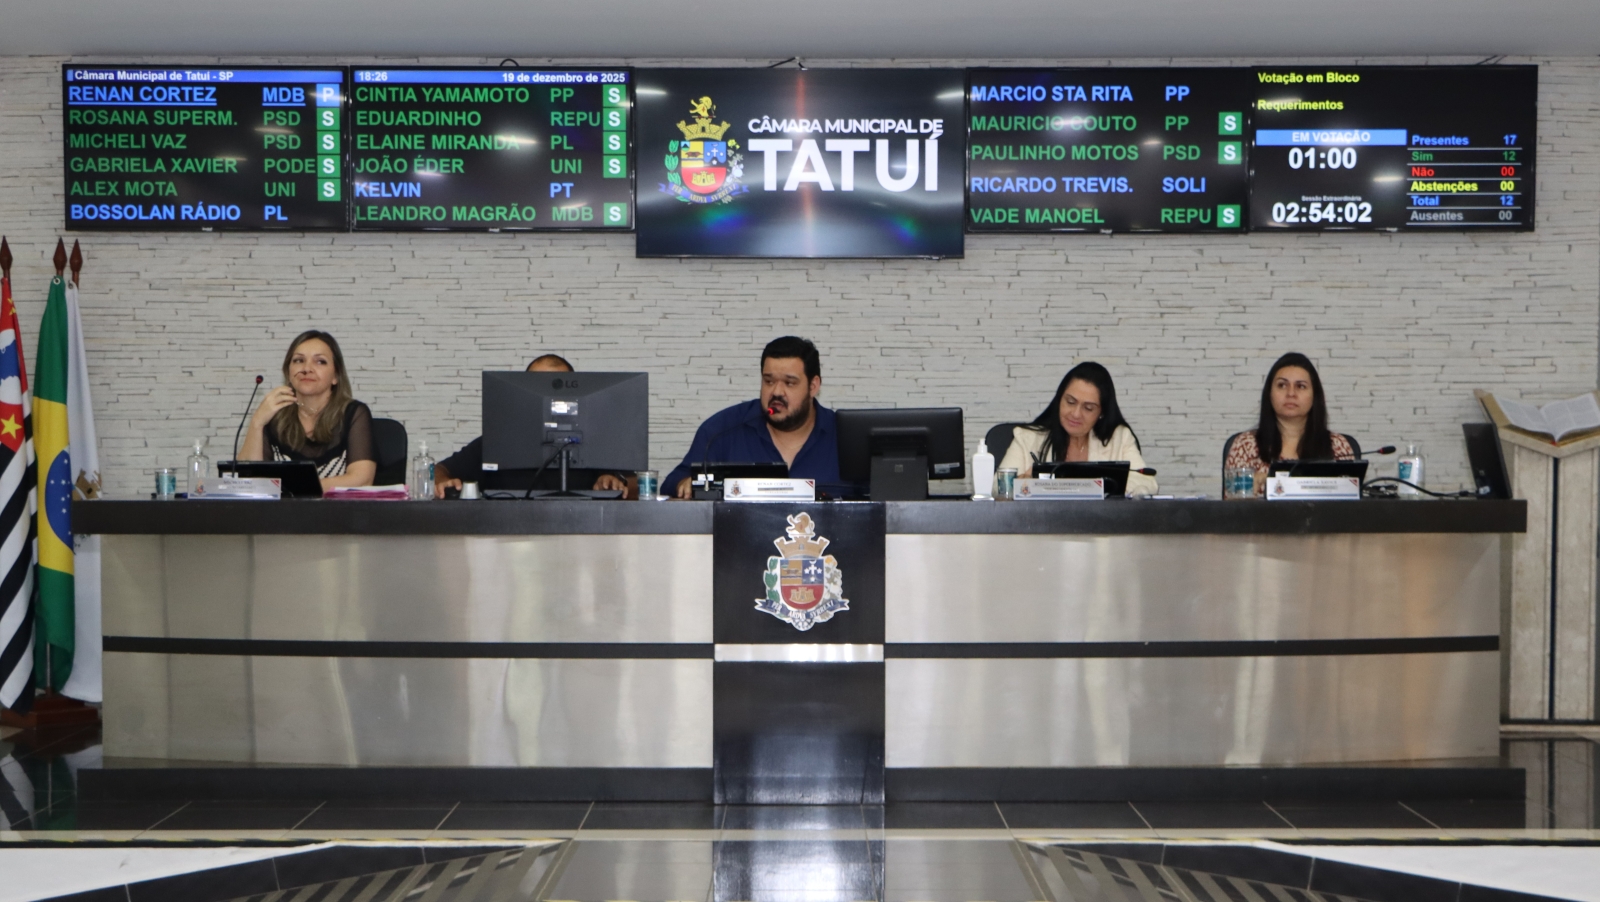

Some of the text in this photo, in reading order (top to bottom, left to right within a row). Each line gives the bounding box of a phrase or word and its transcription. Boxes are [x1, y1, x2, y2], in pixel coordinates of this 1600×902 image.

[74, 70, 115, 81] Câmara
[117, 71, 167, 82] Municipal
[170, 71, 182, 81] de
[185, 71, 210, 81] Tatuí
[219, 72, 234, 81] SP
[358, 72, 388, 81] 18:26
[517, 73, 530, 82] de
[532, 74, 583, 82] dezembro
[601, 74, 625, 82] 2025
[1258, 73, 1303, 84] Votação
[1326, 73, 1359, 82] Bloco
[69, 86, 335, 102] RENAN CORTEZ MDB P
[356, 87, 620, 103] CINTIA YAMAMOTO PP S
[971, 86, 1190, 102] MARCIO STA RITA PP
[1258, 100, 1343, 111] Requerimentos
[69, 110, 335, 126] ROSANA SUPERM. PSD S
[356, 111, 620, 127] EDUARDINHO REPU S
[748, 115, 943, 133] CÂMARA MUNICIPAL DE
[971, 116, 1236, 131] MAURICIO COUTO PP S
[70, 134, 335, 150] MICHELI VAZ PSD S
[356, 135, 621, 150] ELAINE MIRANDA PL S
[1292, 130, 1370, 144] EM VOTAÇÃO
[1411, 135, 1516, 145] Presentes 17
[971, 145, 1236, 160] PAULINHO MOTOS PSD S
[1289, 148, 1357, 169] 01:00
[1411, 151, 1516, 161] Sim 12
[70, 157, 335, 173] GABRIELA XAVIER PODE S
[356, 155, 621, 174] JOÃO ÉDER UNI S
[748, 130, 944, 192] TATUÍ
[1411, 167, 1514, 176] Não 00
[70, 182, 335, 197] ALEX MOTA UNI S
[356, 183, 574, 197] KELVIN PT
[971, 177, 1206, 193] RICARDO TREVIS. SOLI
[1410, 181, 1514, 193] Abstenções 00
[1411, 196, 1513, 205] Total 12
[71, 201, 288, 220] BOSSOLAN RÁDIO PL
[356, 203, 621, 221] LEANDRO MAGRÃO MDB S
[971, 208, 1235, 223] VADE MANOEL REPU S
[1272, 202, 1372, 222] 02:54:02
[1410, 211, 1512, 220] Ausentes 00
